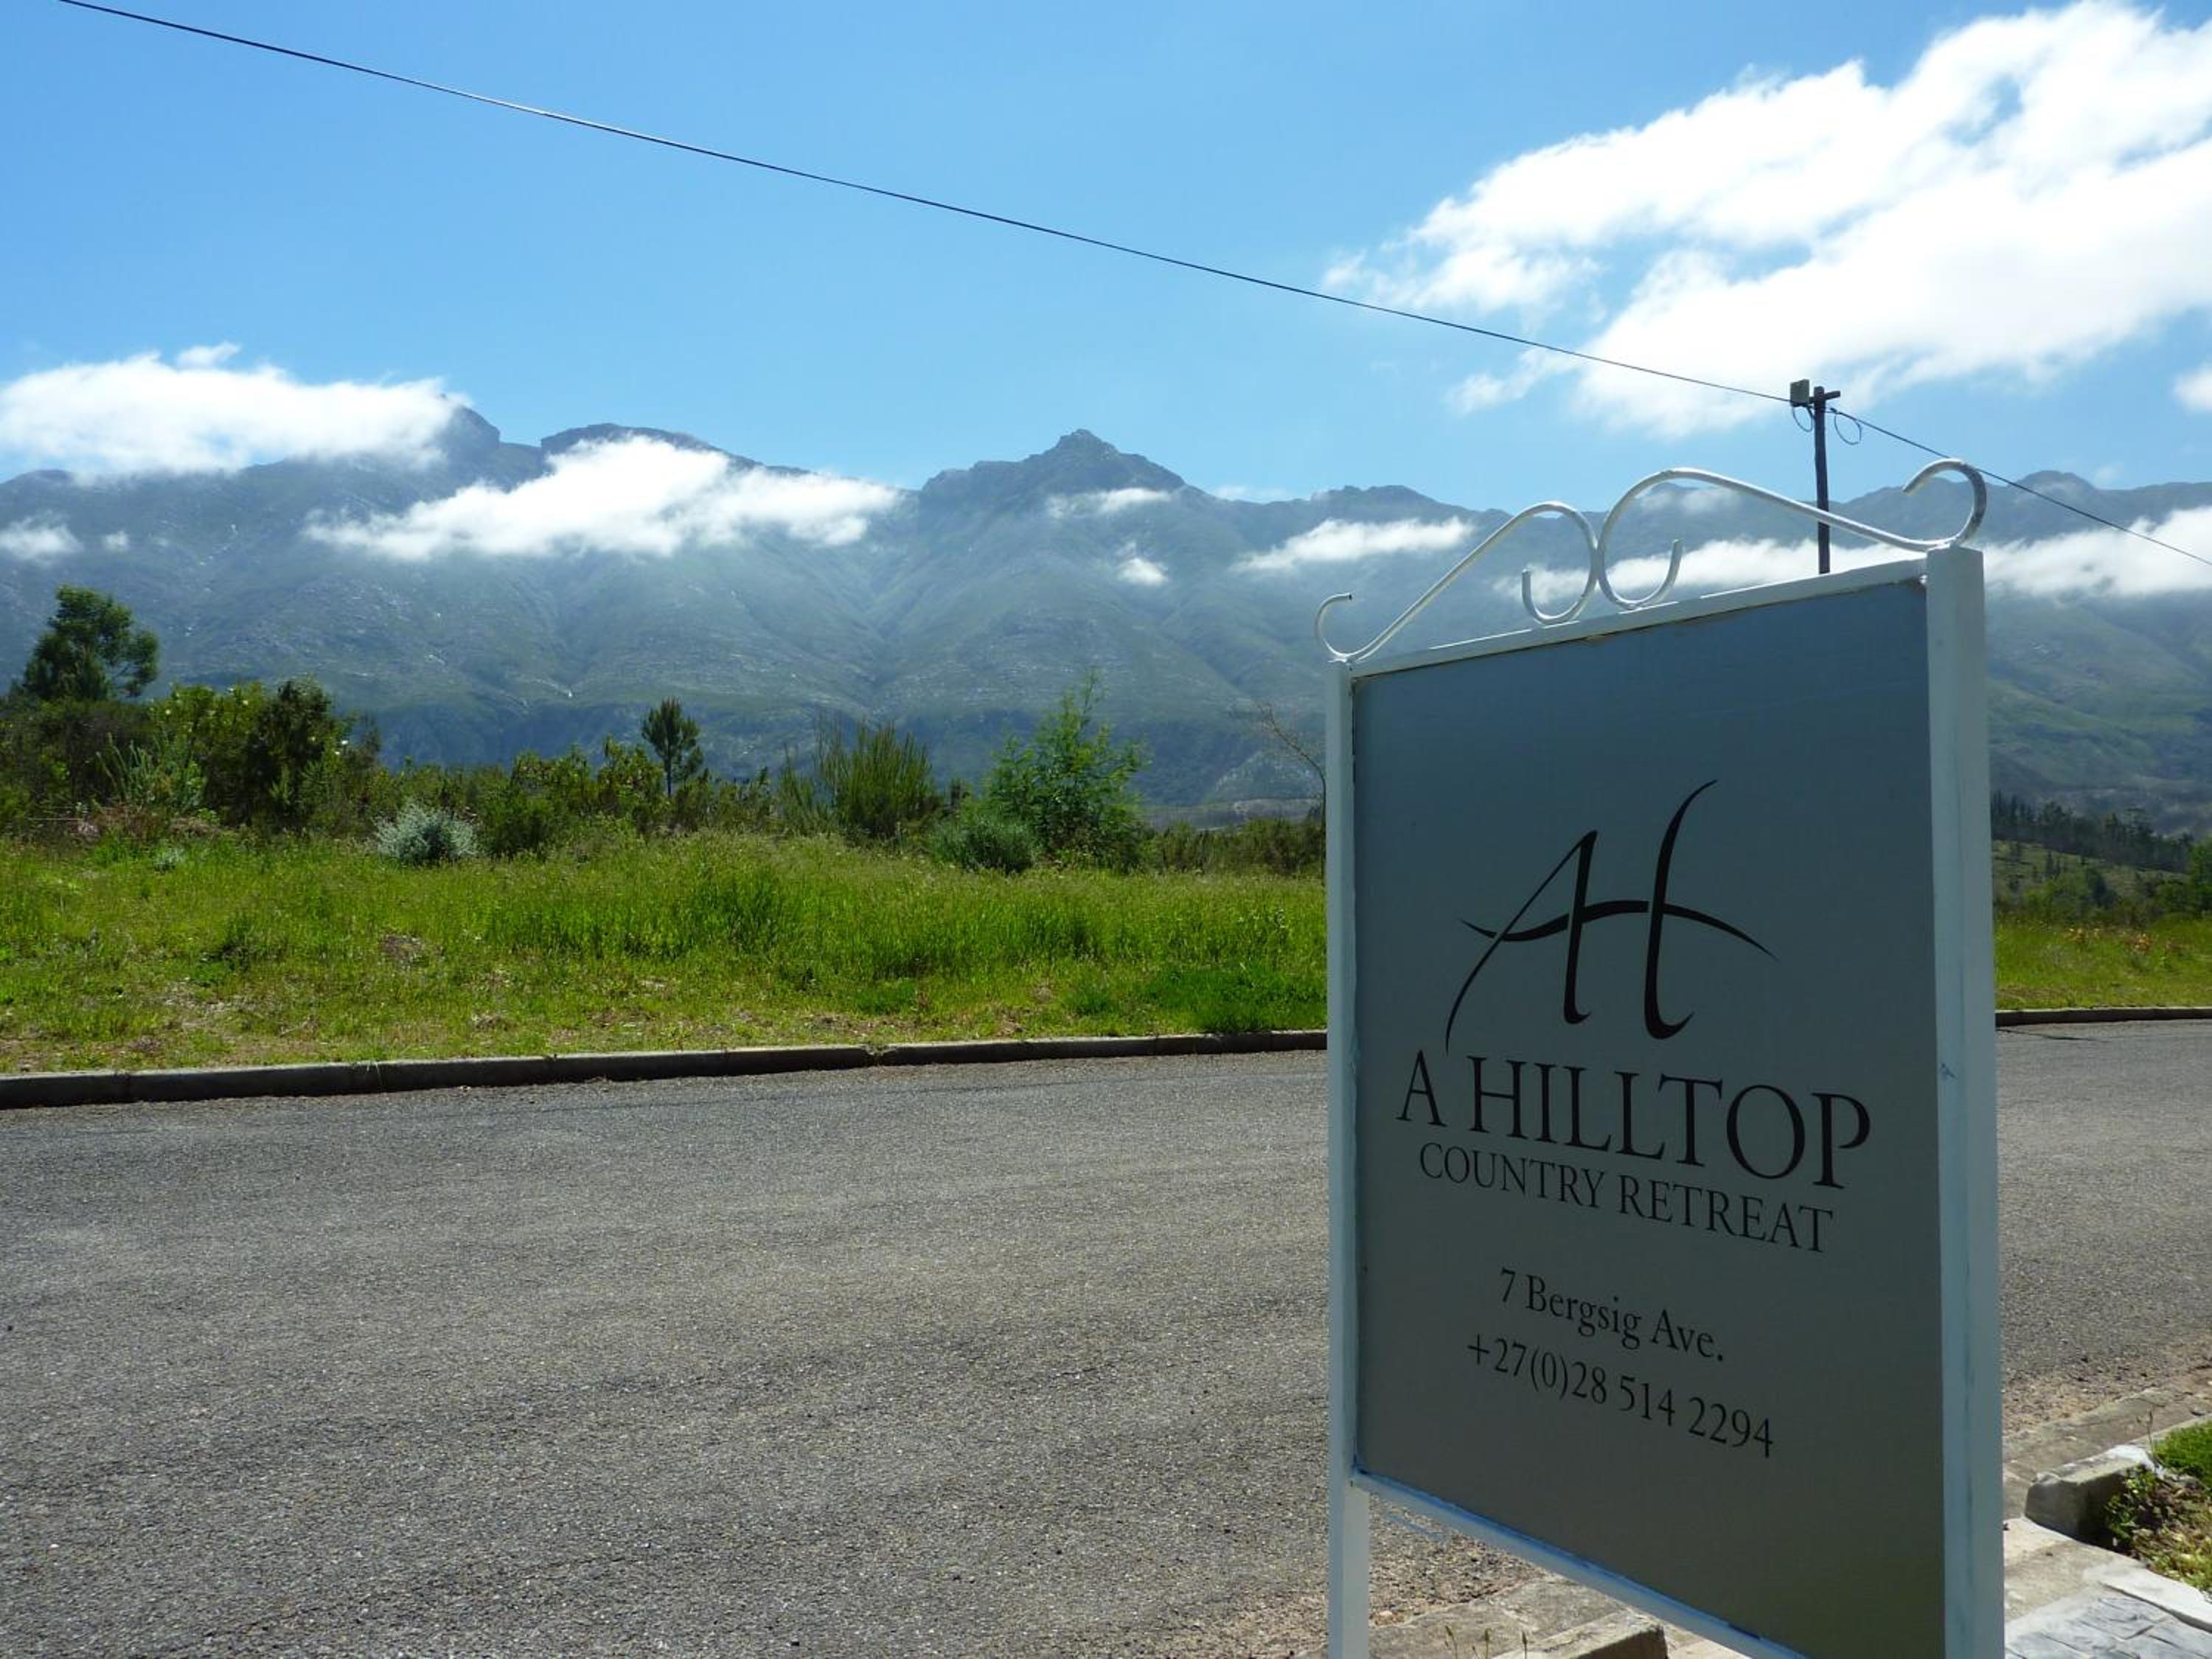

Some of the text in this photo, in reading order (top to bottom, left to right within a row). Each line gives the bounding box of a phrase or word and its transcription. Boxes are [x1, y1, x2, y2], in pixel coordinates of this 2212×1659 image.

[1395, 1049, 1871, 1189] A HILLTOP
[1419, 1141, 1833, 1253] COUNTRY RETREAT
[1500, 1267, 1724, 1363] 7 Bergsig Ave.
[1467, 1332, 1774, 1459] +27(0)28 514 2294
